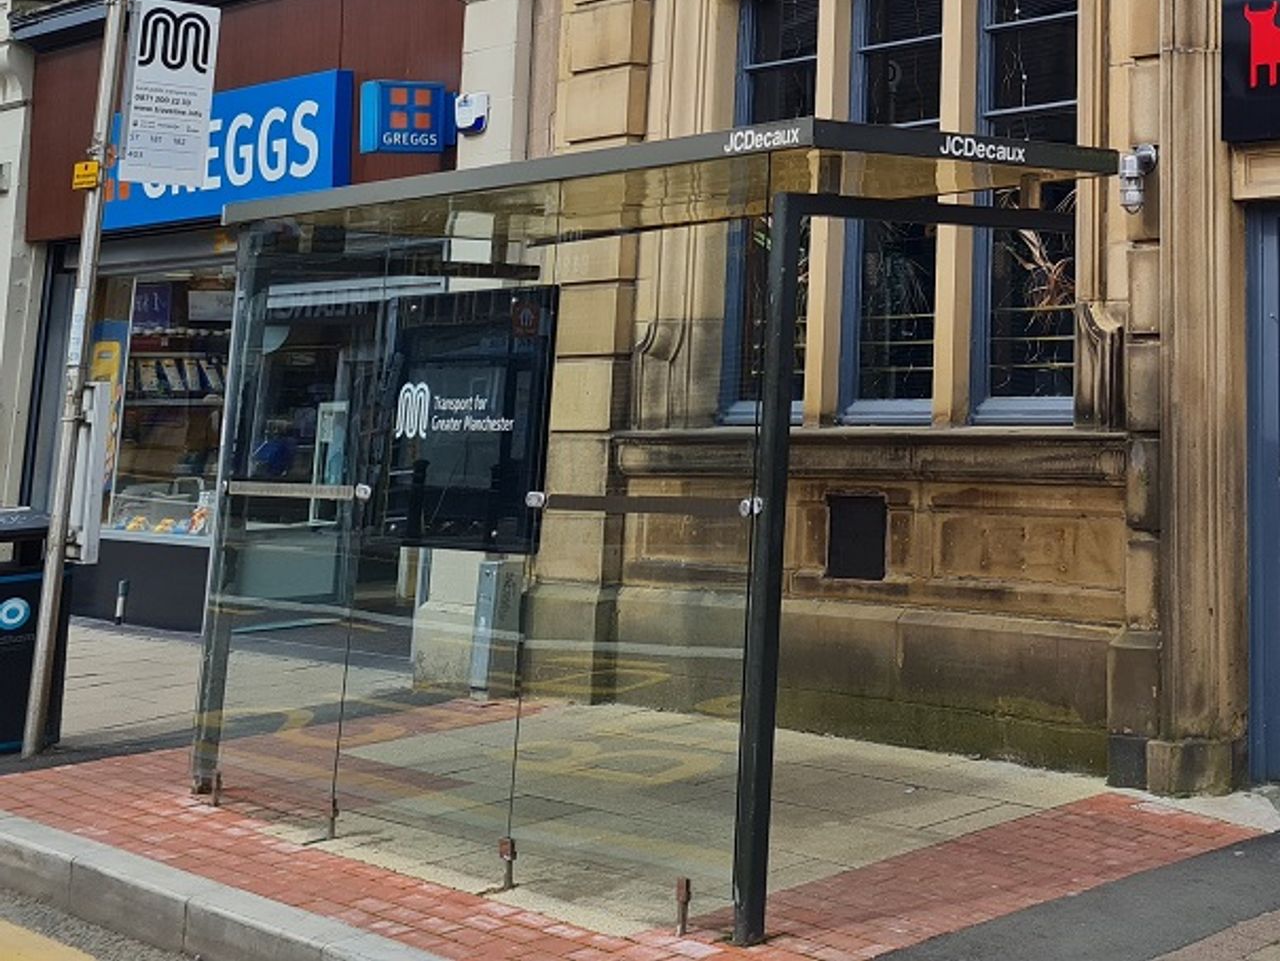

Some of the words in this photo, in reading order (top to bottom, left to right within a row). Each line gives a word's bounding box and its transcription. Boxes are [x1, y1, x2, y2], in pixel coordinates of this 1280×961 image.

[143, 99, 319, 199] EGGS
[382, 131, 438, 146] GREGGS
[723, 127, 801, 153] JCDecaux
[940, 135, 1026, 164] JCDecaux
[433, 394, 473, 413] Transport
[474, 393, 488, 410] for
[431, 415, 462, 431] Greater
[463, 415, 515, 431] Manchester
